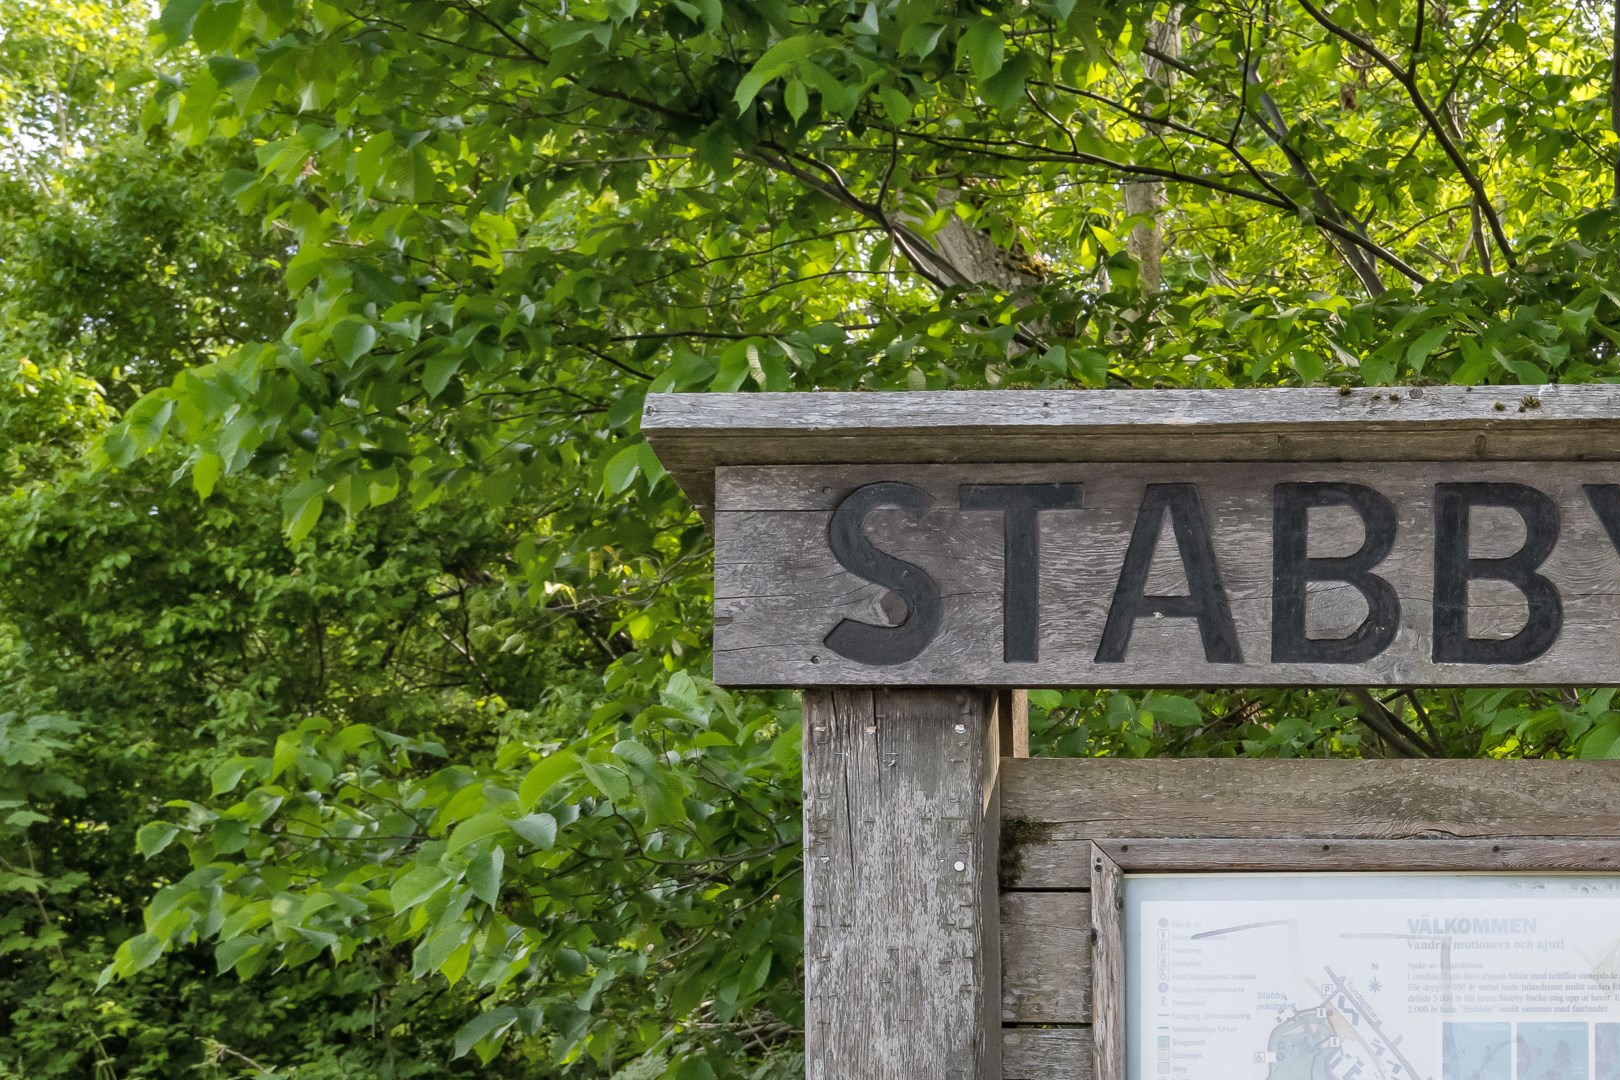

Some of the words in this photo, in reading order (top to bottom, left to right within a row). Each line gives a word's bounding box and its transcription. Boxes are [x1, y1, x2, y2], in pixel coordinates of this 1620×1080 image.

[1407, 914, 1537, 934] VÄLKOMMEN
[1453, 939, 1510, 950] motionera
[1514, 939, 1533, 950] och
[1537, 939, 1565, 952] njut!
